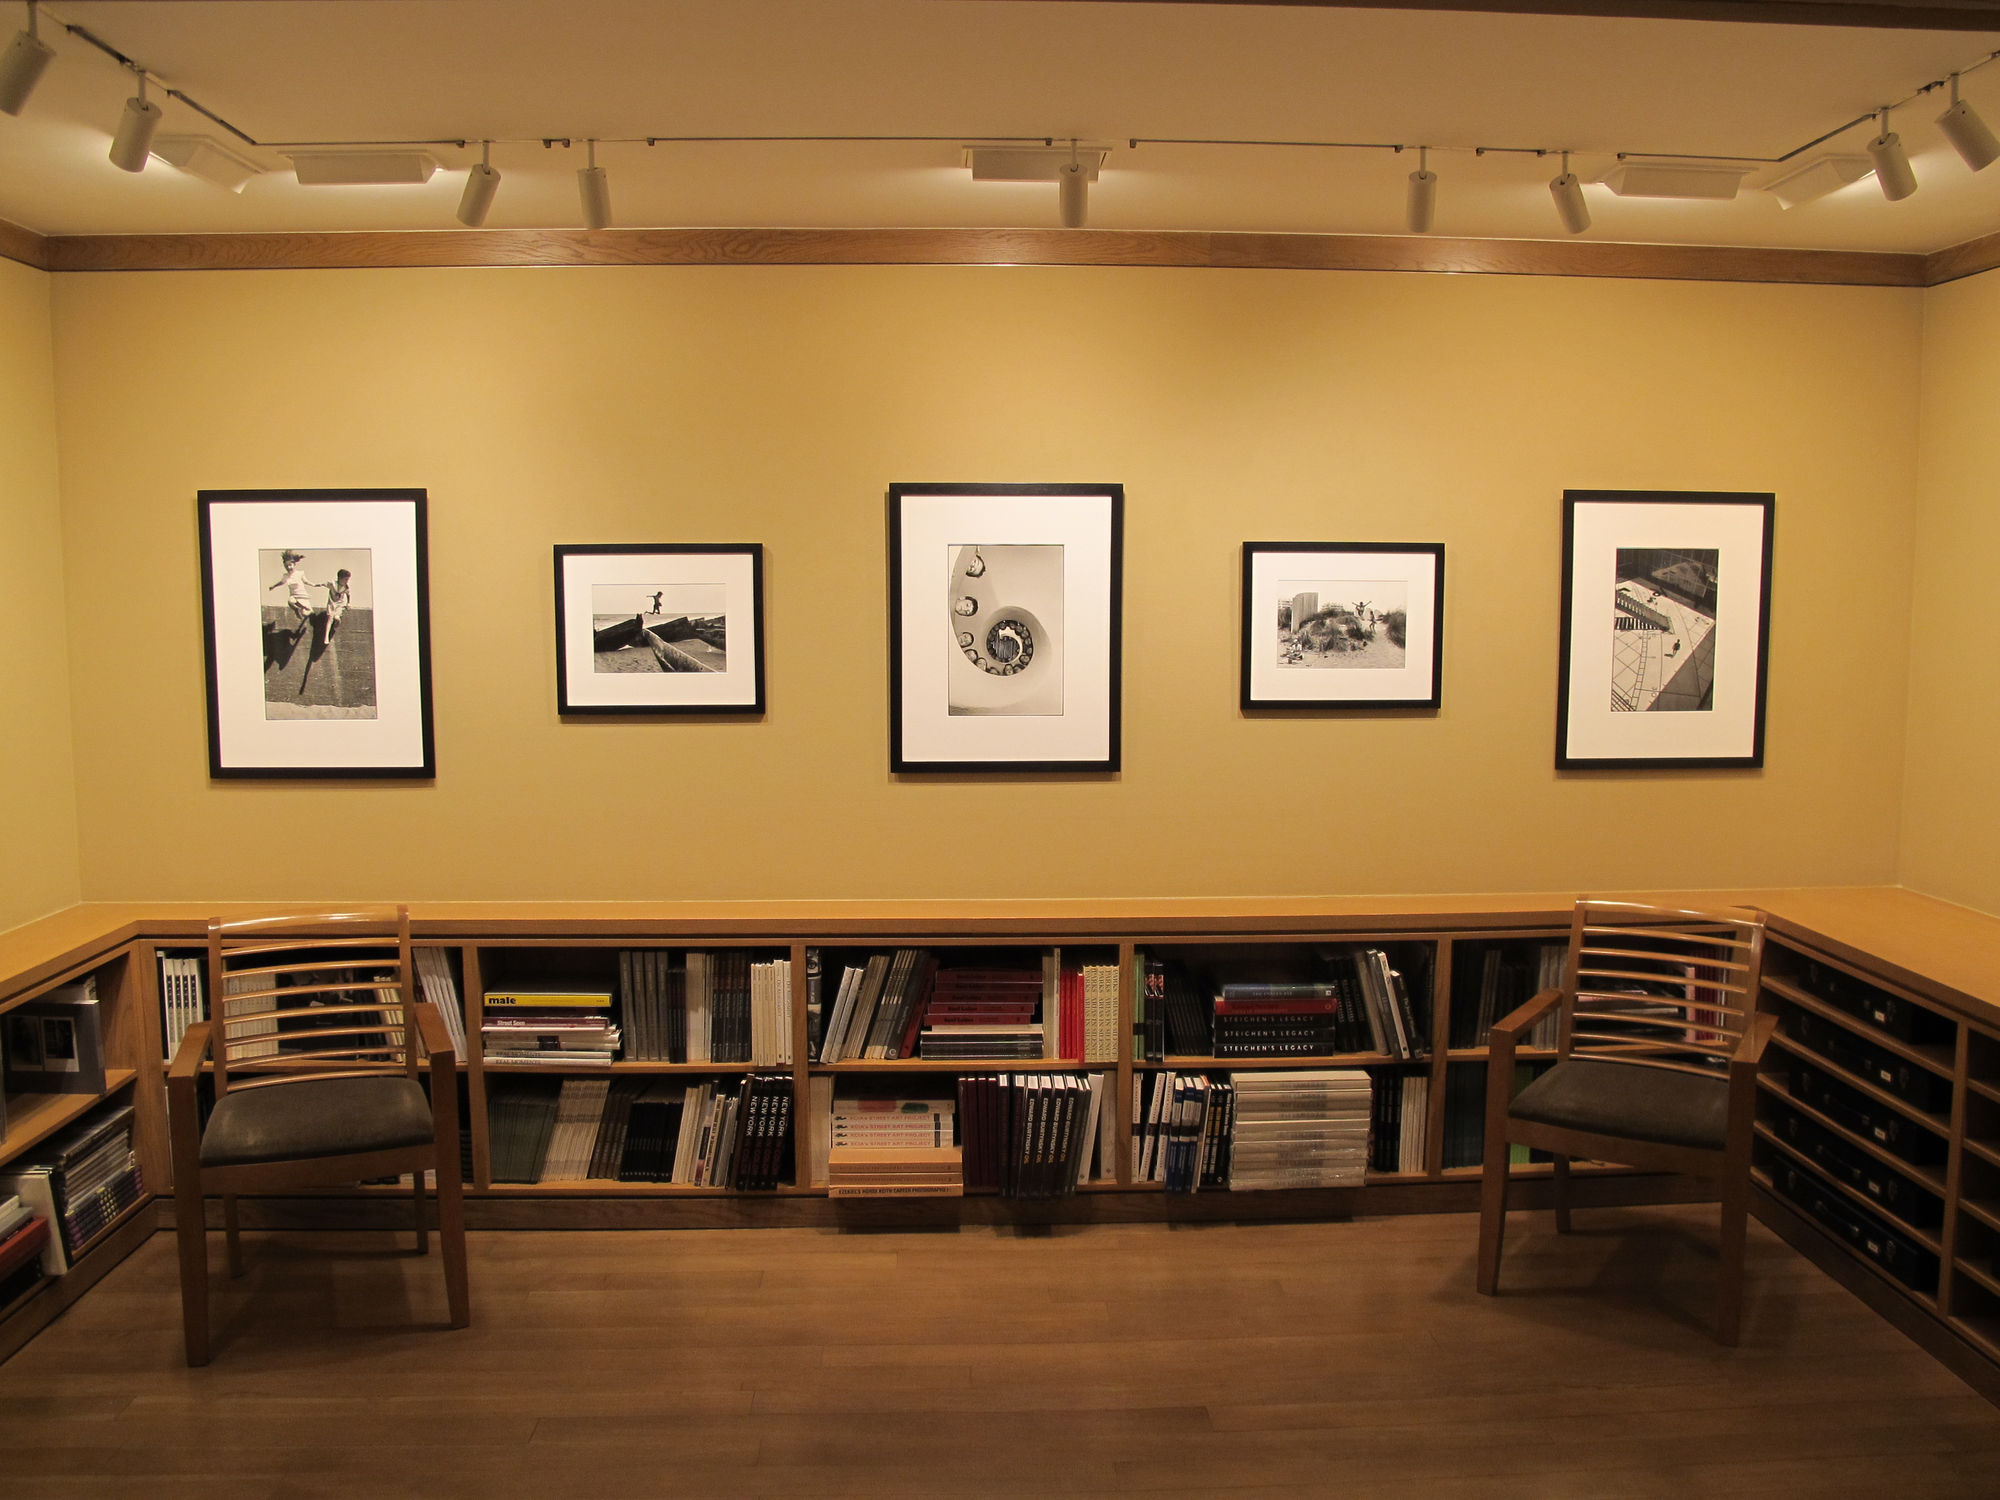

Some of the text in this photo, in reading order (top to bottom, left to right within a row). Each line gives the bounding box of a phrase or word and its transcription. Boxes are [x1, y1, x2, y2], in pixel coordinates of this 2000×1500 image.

[488, 997, 516, 1005] male
[750, 1096, 758, 1114] NEW
[761, 1096, 769, 1114] NEW
[771, 1096, 779, 1114] NEW
[780, 1096, 789, 1114] NEW
[1027, 1099, 1035, 1121] EDWARD
[1053, 1098, 1062, 1121] EDWARD
[1066, 1097, 1074, 1120] EDWARD
[746, 1116, 754, 1137] YORK
[768, 1116, 776, 1137] YORK
[777, 1116, 785, 1137] YORK
